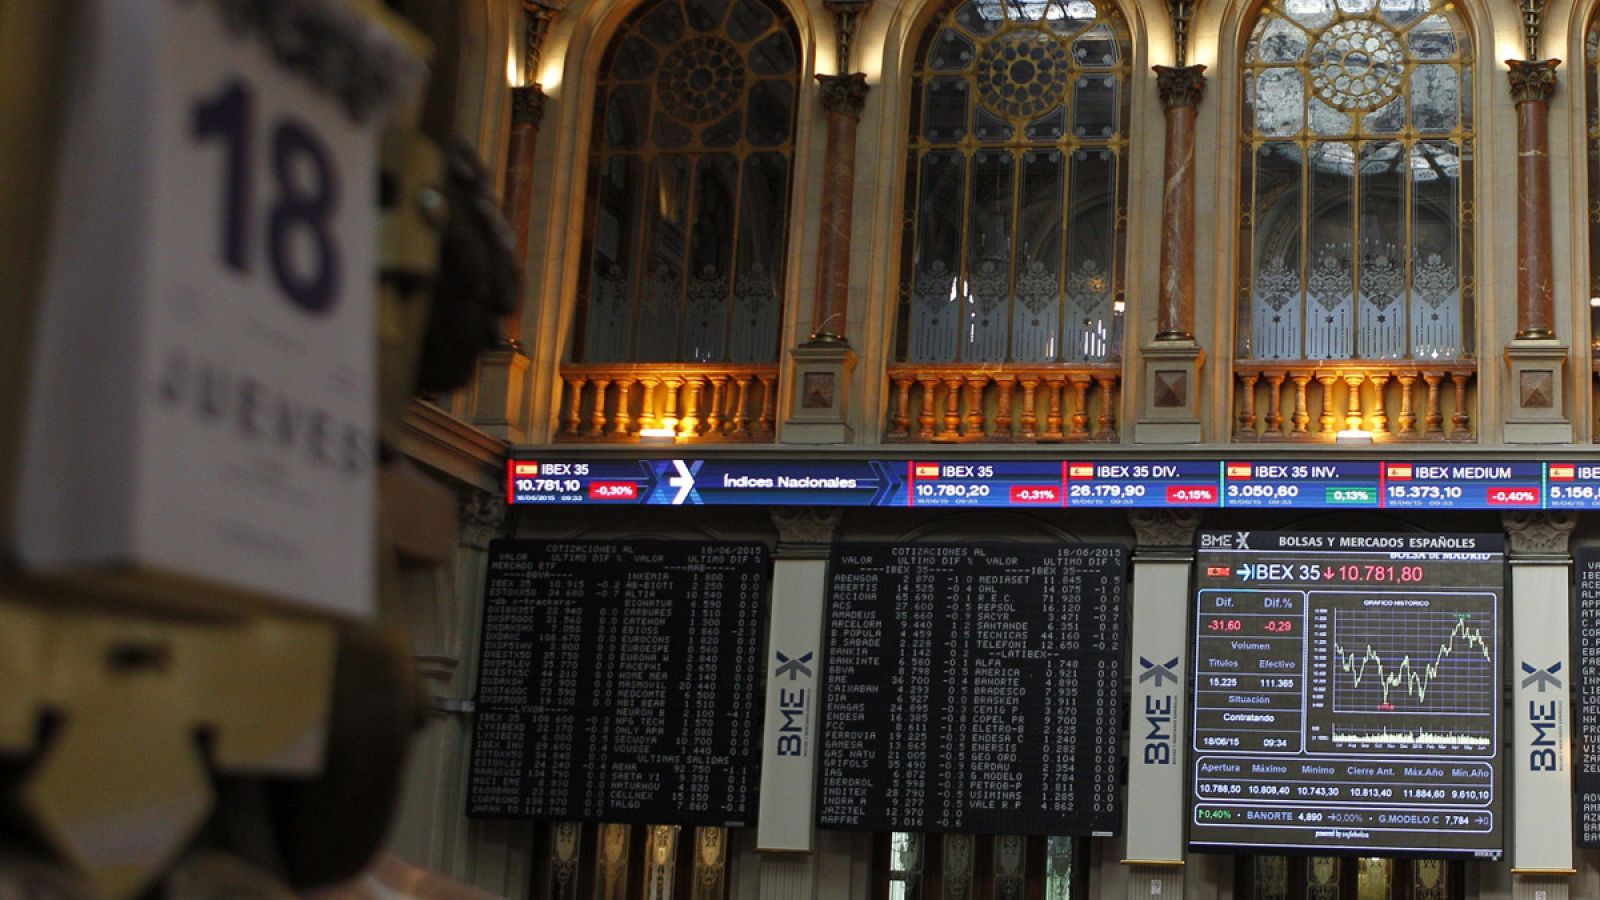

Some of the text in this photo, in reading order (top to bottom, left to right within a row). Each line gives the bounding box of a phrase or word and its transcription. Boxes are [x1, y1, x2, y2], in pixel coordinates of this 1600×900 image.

[192, 76, 342, 318] 18
[158, 352, 368, 476] JUEVES
[541, 464, 589, 476] IBEX 35
[942, 465, 993, 478] IBEX 35
[1097, 465, 1180, 478] IBEX 35 DIV.
[1255, 466, 1340, 478] IBEX 35 INV.
[1415, 467, 1512, 479] IBEX MEDIUM
[516, 479, 580, 493] 10.781,10
[723, 473, 857, 489] Índices Nacionales
[594, 485, 633, 497] -0,30%
[915, 484, 990, 498] 10.780,20
[1015, 490, 1055, 501] -0,31%
[1070, 484, 1145, 498] 26.179,90
[1172, 490, 1212, 501] -0,15%
[1227, 485, 1299, 499] 3.050,60
[1333, 490, 1369, 501] 0,13%
[1387, 486, 1462, 500] 15.373,10
[1491, 491, 1534, 502] -0,40%
[1201, 534, 1233, 547] BME
[1279, 535, 1476, 549] BOLSAS Y MERCADOS ESPAÑOLES
[546, 545, 617, 553] COTIZACIONES
[701, 546, 762, 555] 18/06/2015
[891, 547, 1121, 557] COTIZACIONES AL 18/06/2015
[841, 556, 1082, 566] VALOR ULTIMO DIF VALOR ULTIMO
[1251, 564, 1321, 581] IBEX 35
[1339, 566, 1424, 584] 10.781,80
[834, 574, 879, 583] ABENGOA
[979, 575, 1030, 585] MEDIASET
[833, 583, 878, 592] ABERTIS
[833, 592, 877, 601] ACCIONA
[977, 603, 1016, 612] REPSOL
[1215, 597, 1235, 608] Dif.
[1264, 597, 1293, 609] Dif.%
[831, 610, 877, 619] AMADEUS
[977, 612, 1010, 621] SACYR
[977, 622, 1029, 631] SANTANDE
[1231, 641, 1271, 650] Volumen
[829, 647, 869, 656] BANKIA
[829, 657, 881, 665] BANKINTE
[975, 658, 1002, 667] ALFA
[1259, 659, 1296, 669] Efectivo
[974, 668, 1021, 677] AMERICA
[974, 677, 1020, 686] BANORTE
[973, 687, 1026, 696] BRADESCO
[973, 696, 1020, 705] BRASKEM
[1228, 695, 1270, 705] Situación
[826, 712, 865, 721] ENDESA
[1223, 712, 1276, 723] Contratando
[777, 688, 805, 757] BME
[1144, 695, 1171, 765] BME
[1203, 737, 1240, 746] 18/06/15
[1529, 700, 1557, 772] BME
[971, 743, 1017, 752] ENERSIS
[1263, 738, 1288, 748] 09:34
[970, 762, 1010, 771] GERDAU
[1201, 763, 1241, 774] Apertura
[1347, 766, 1396, 776] Cierre Ant.
[823, 787, 868, 796] INDITEX
[1297, 786, 1340, 797] 10.743,30
[821, 806, 866, 816] JAZZTEL
[820, 815, 859, 825] MAPFRE
[1247, 811, 1293, 821] BANORTE
[1297, 812, 1323, 822] 4,890
[1432, 816, 1440, 825] C
[1444, 815, 1470, 826] 7,784
